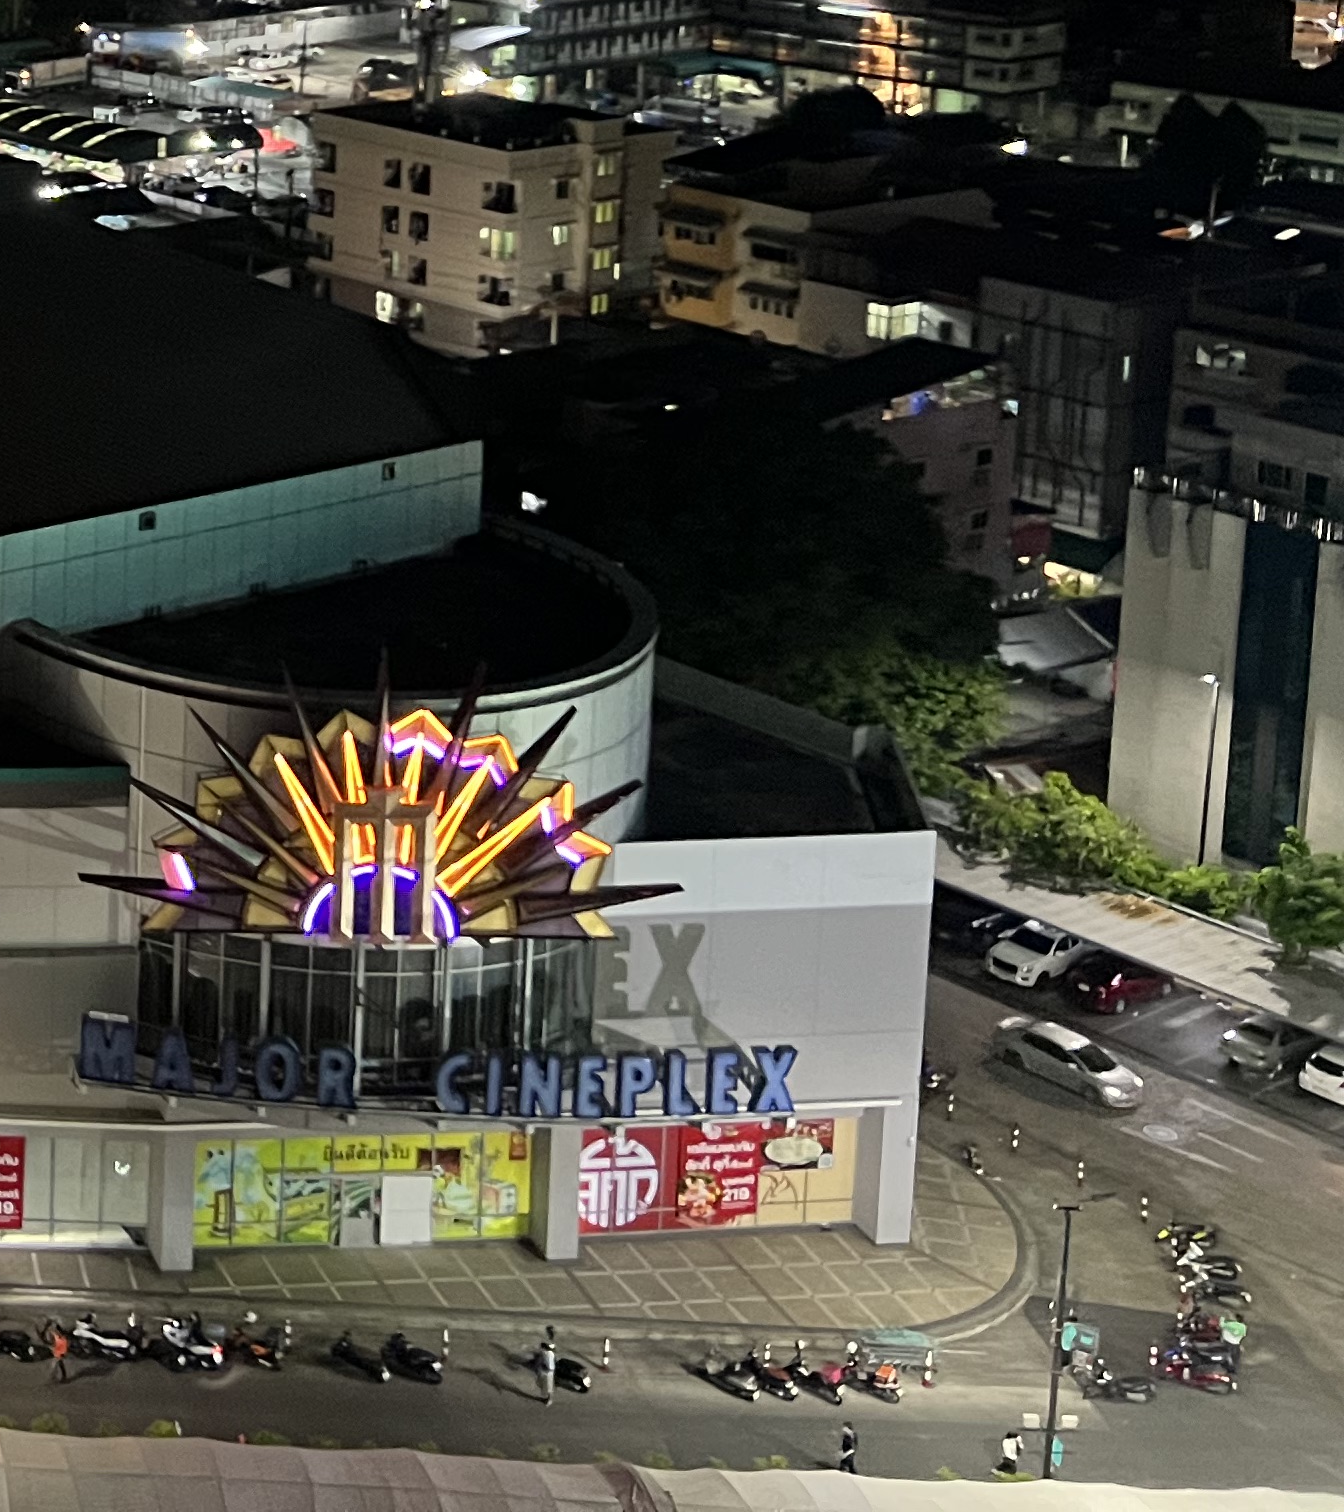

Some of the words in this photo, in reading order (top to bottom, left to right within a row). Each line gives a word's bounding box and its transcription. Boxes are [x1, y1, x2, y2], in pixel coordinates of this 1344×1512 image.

[80, 1019, 357, 1110] MAJOR
[435, 1044, 799, 1118] CINEPLEX
[323, 1143, 411, 1162] ยินดีต้อนรับ
